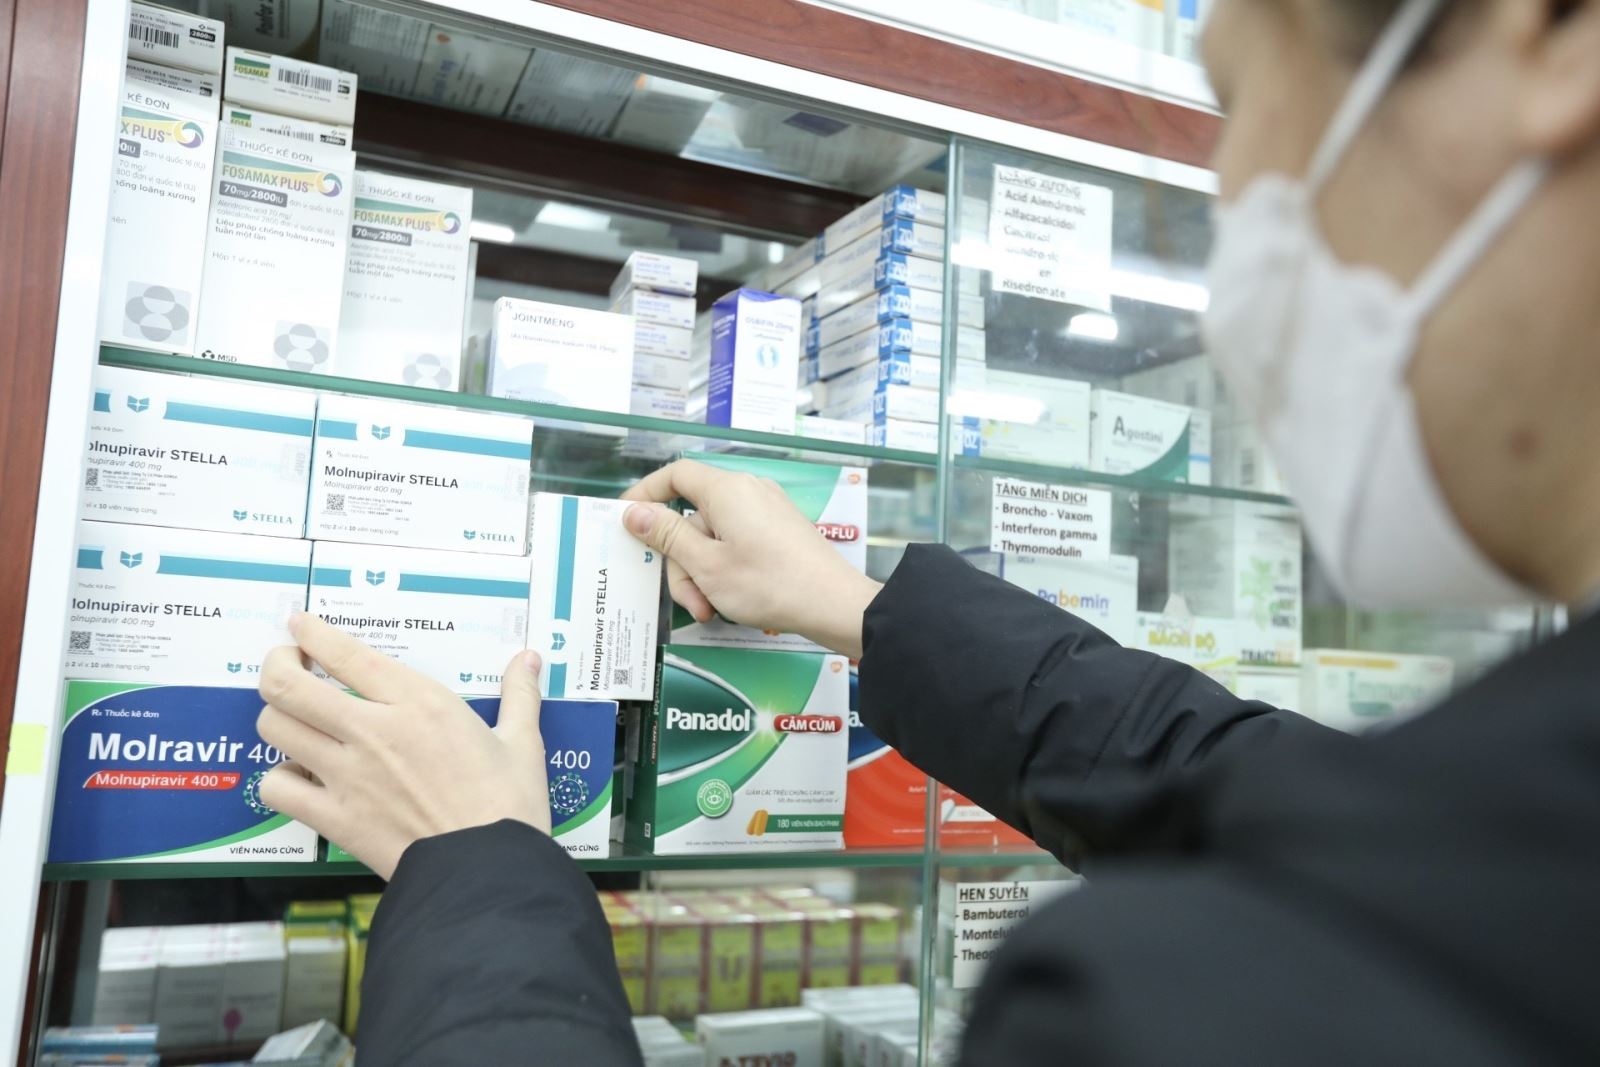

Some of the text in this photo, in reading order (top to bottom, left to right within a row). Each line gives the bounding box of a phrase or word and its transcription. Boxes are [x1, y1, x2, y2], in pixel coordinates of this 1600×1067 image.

[233, 64, 270, 79] FOSAMAX
[222, 164, 278, 187] FOSAMAX
[353, 210, 403, 228] FOSAMAX
[1113, 415, 1164, 443] Agostini
[170, 449, 228, 466] STELLA
[128, 460, 146, 469] 400
[147, 462, 162, 472] mg
[324, 465, 459, 489] Molnupiravir STELLA
[323, 480, 404, 497] Molnupiravir 400 mg
[996, 482, 1027, 497] TĂNG
[1063, 491, 1088, 504] DỊCH
[252, 513, 293, 525] STELLA
[1003, 503, 1093, 522] Broncho Vaxom
[479, 532, 516, 544] STELLA
[1002, 522, 1098, 541] Interferon gamma
[1001, 540, 1082, 558] Thymomodulin
[163, 603, 222, 619] STELLA
[121, 617, 139, 626] 400
[141, 619, 155, 628] mg
[404, 618, 455, 632] STELLA
[590, 567, 608, 691] Molnupiravir STELLA
[368, 631, 398, 641] 400 mg
[105, 708, 130, 718] Thuốc
[132, 709, 142, 718] kê
[142, 710, 160, 718] đơn
[665, 707, 836, 733] Panadol CẢM CÚM
[88, 732, 243, 763] Molravir
[550, 750, 591, 769] 400
[95, 773, 237, 788] Molnupiravir 400 mg
[777, 819, 789, 828] 180
[230, 844, 304, 855] VIÊN NANG CỨNG
[579, 842, 599, 852] CỨNG
[960, 888, 985, 900] HEN
[963, 906, 1029, 921] Bambuterol
